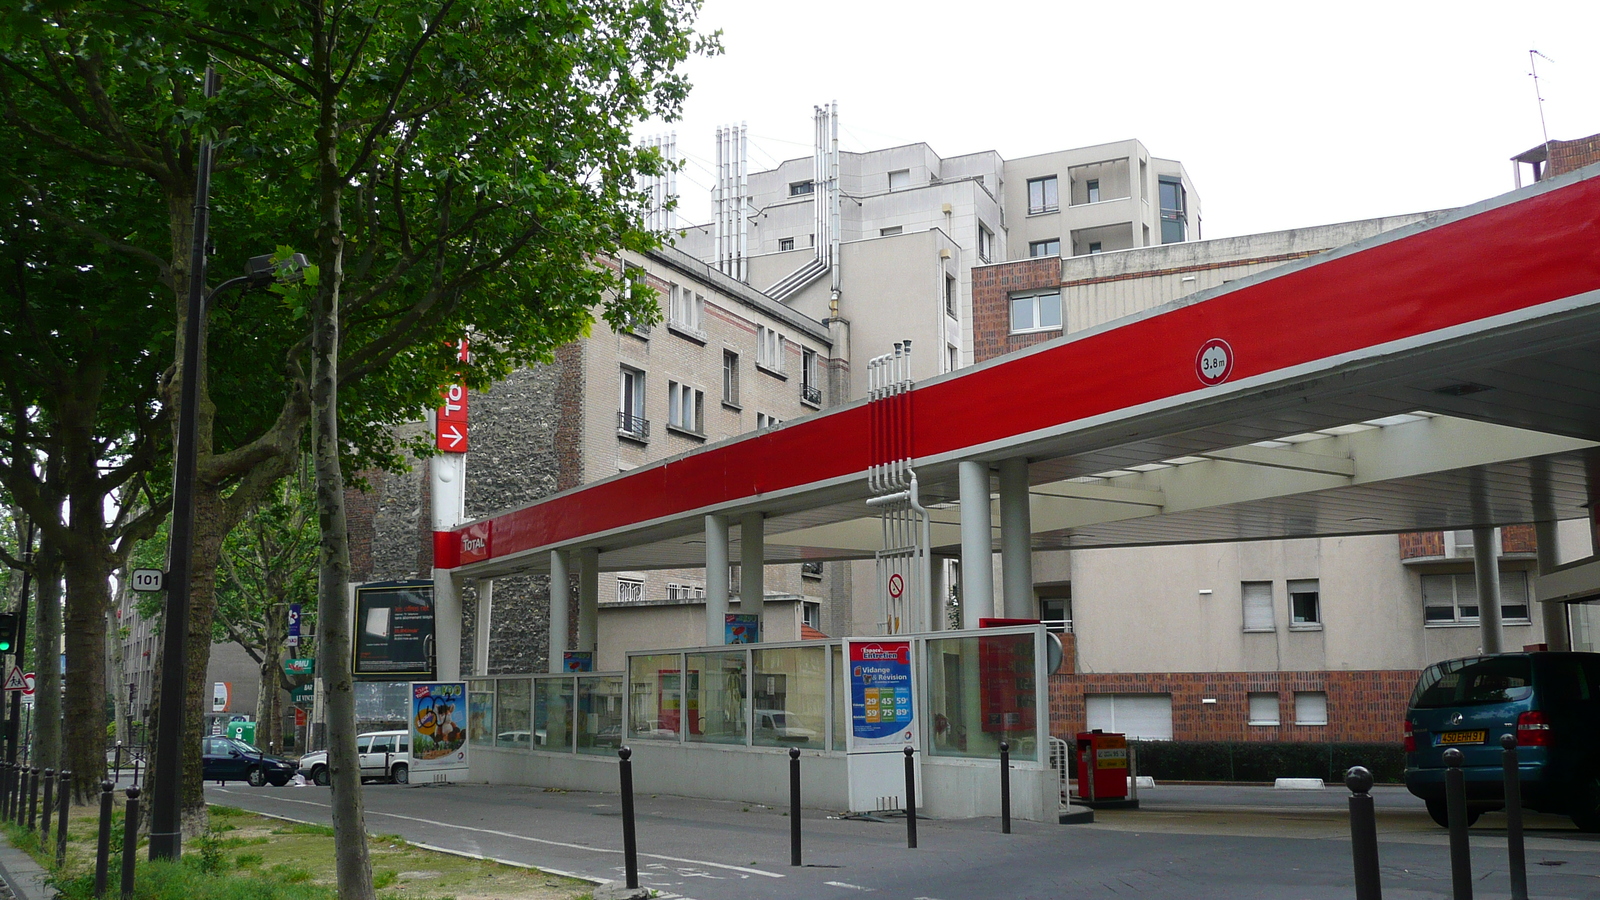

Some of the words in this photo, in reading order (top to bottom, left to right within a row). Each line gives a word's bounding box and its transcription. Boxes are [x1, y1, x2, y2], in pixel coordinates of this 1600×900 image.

[463, 538, 486, 551] TOTAL
[136, 574, 159, 586] 101
[862, 666, 890, 674] Vidange
[1442, 732, 1456, 742] 450
[1457, 731, 1472, 741] EHH
[1473, 730, 1482, 740] 91
